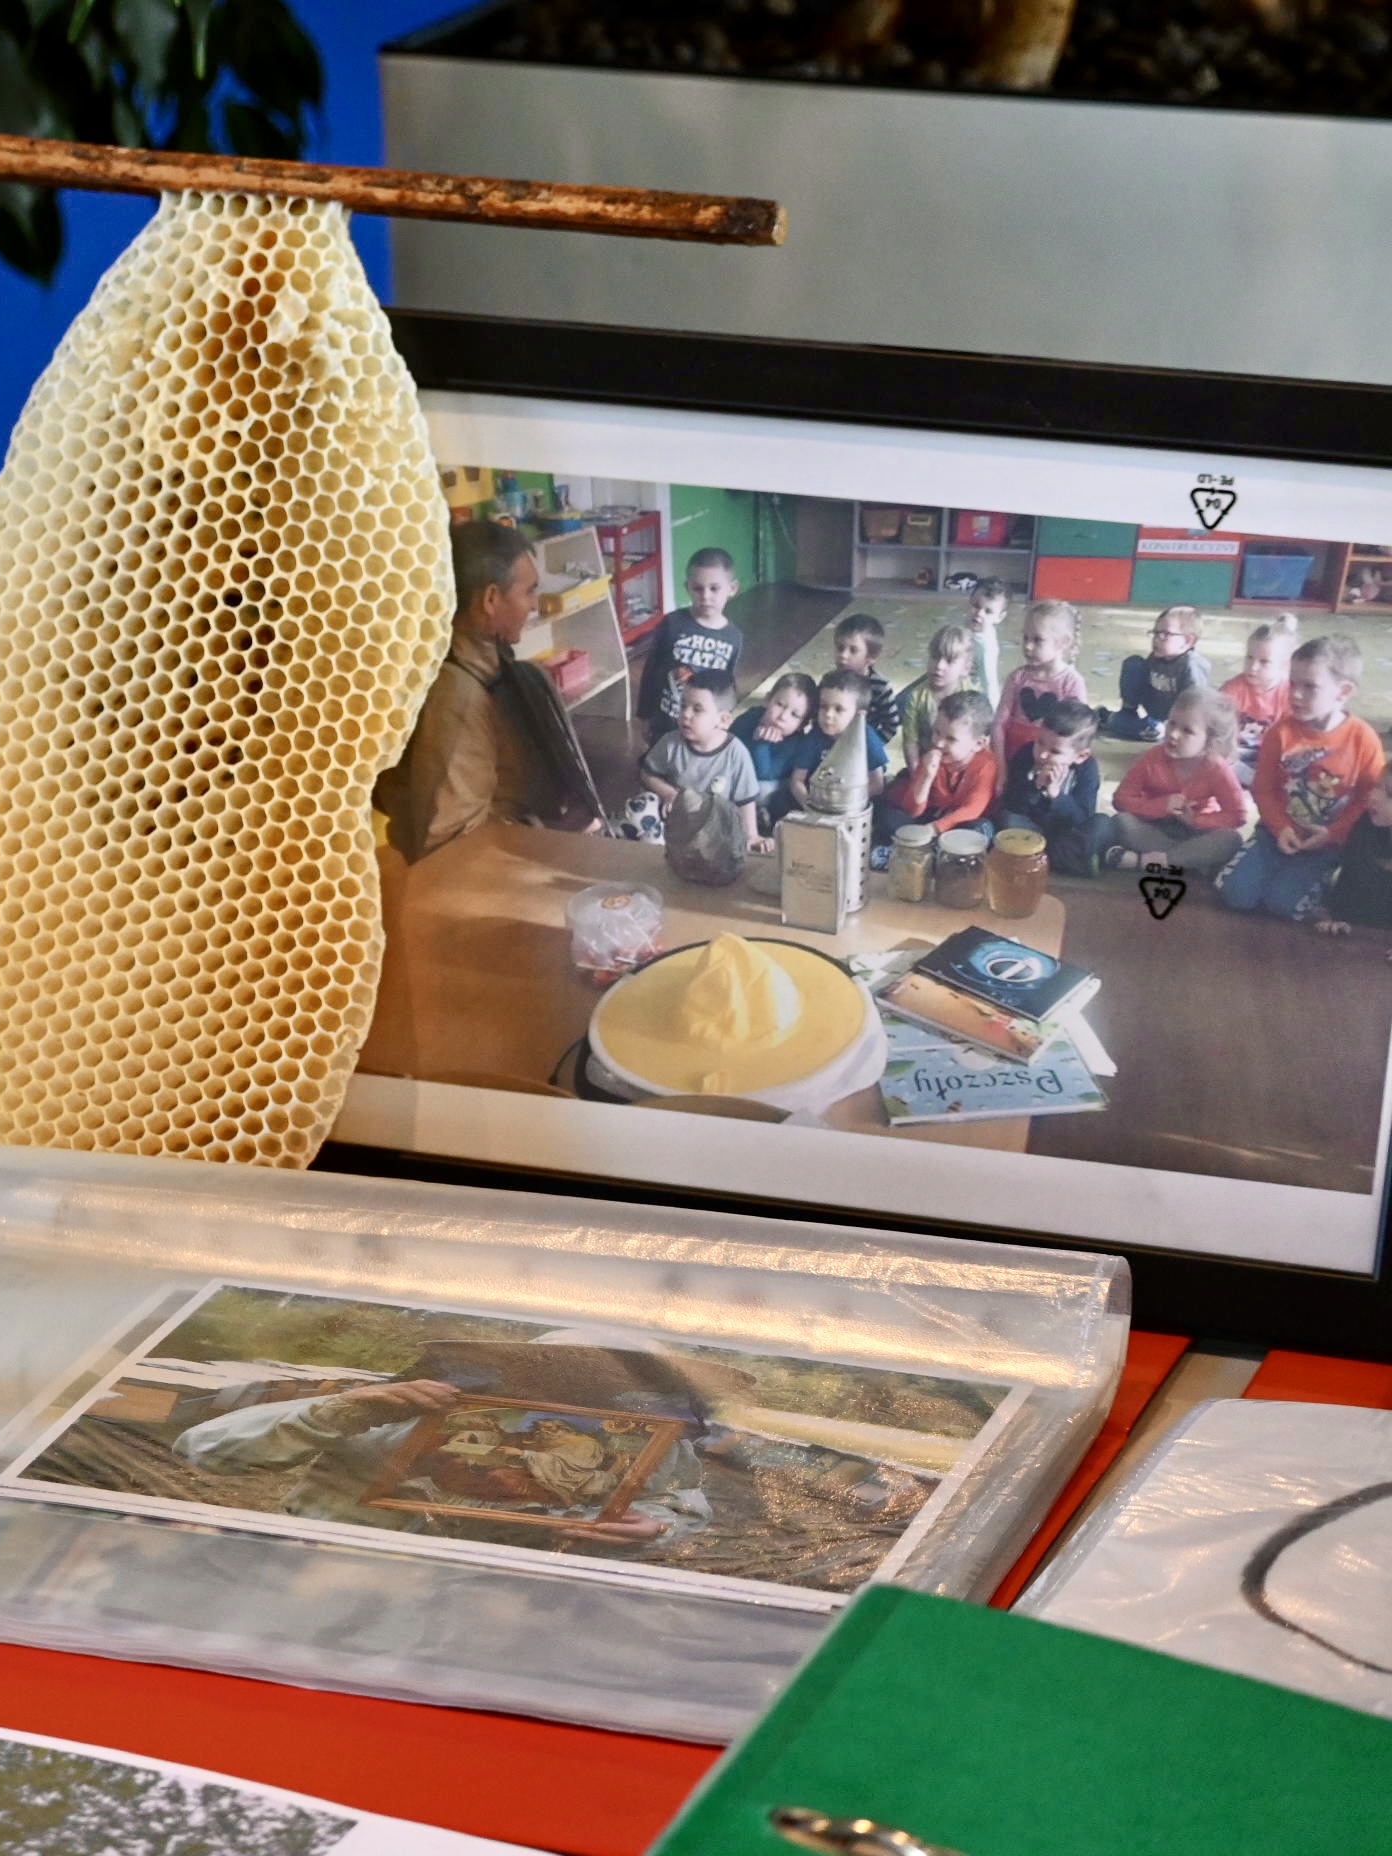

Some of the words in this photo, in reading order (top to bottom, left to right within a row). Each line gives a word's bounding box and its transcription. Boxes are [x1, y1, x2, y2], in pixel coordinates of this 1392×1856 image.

[1197, 473, 1235, 486] PE-LD
[1205, 498, 1222, 509] 04
[913, 1068, 1065, 1101] Pszczoły
